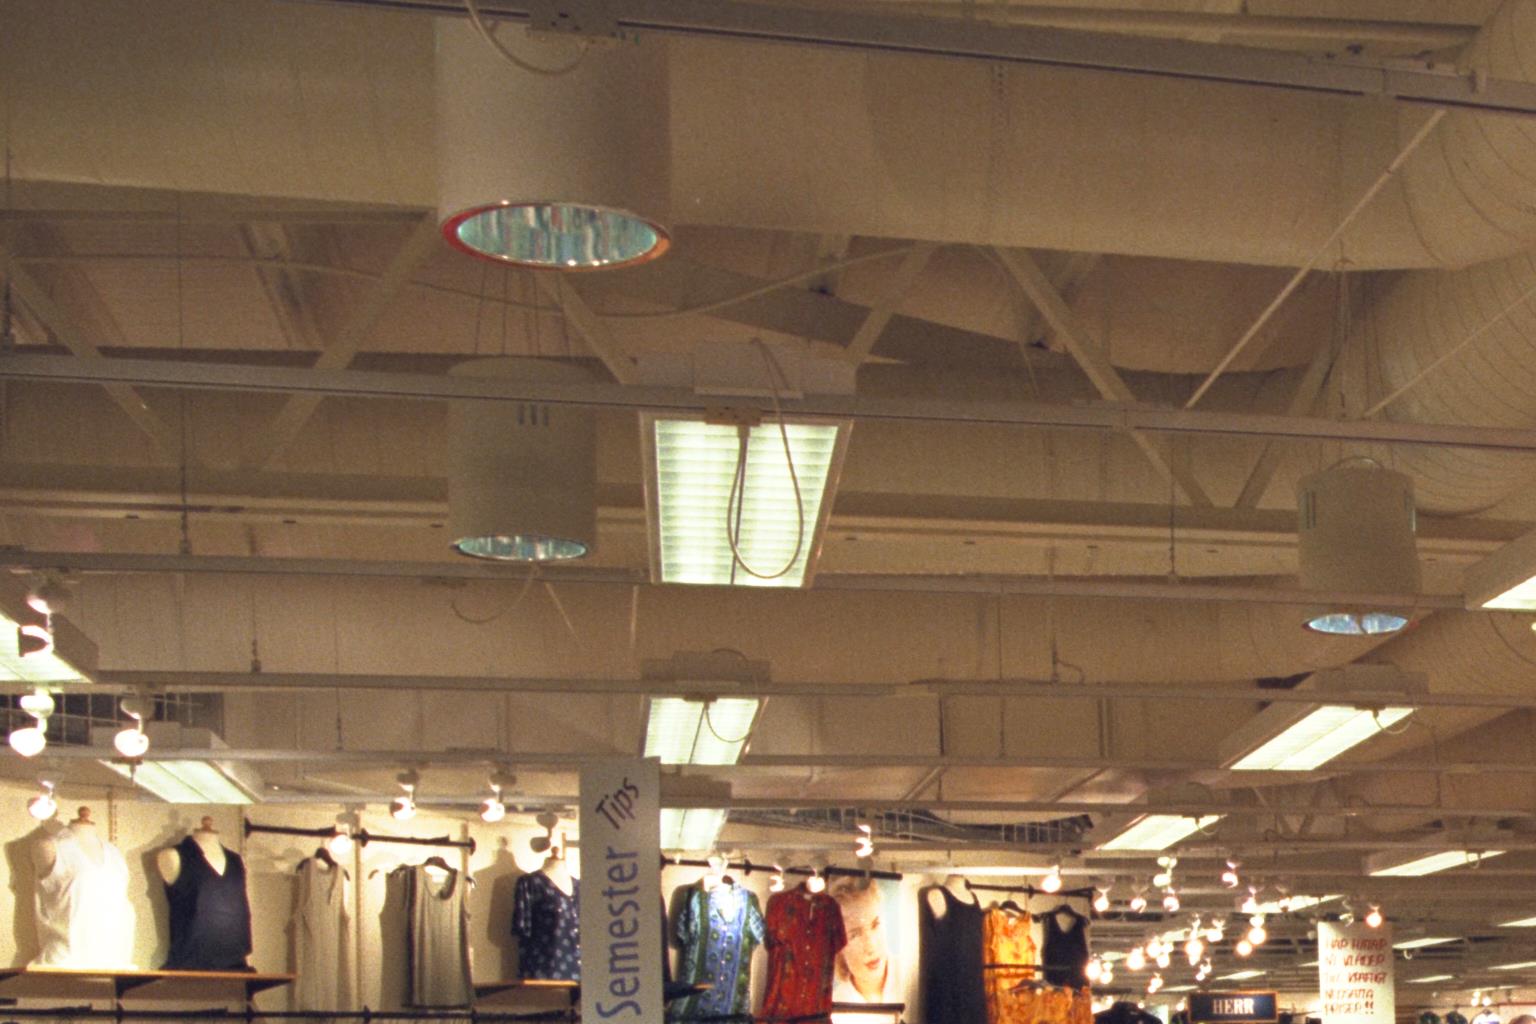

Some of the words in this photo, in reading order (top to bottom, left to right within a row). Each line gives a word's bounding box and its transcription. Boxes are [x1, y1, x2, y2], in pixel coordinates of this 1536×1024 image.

[595, 776, 640, 831] Tips
[596, 846, 642, 1019] Semester
[1213, 998, 1255, 1015] HERR
